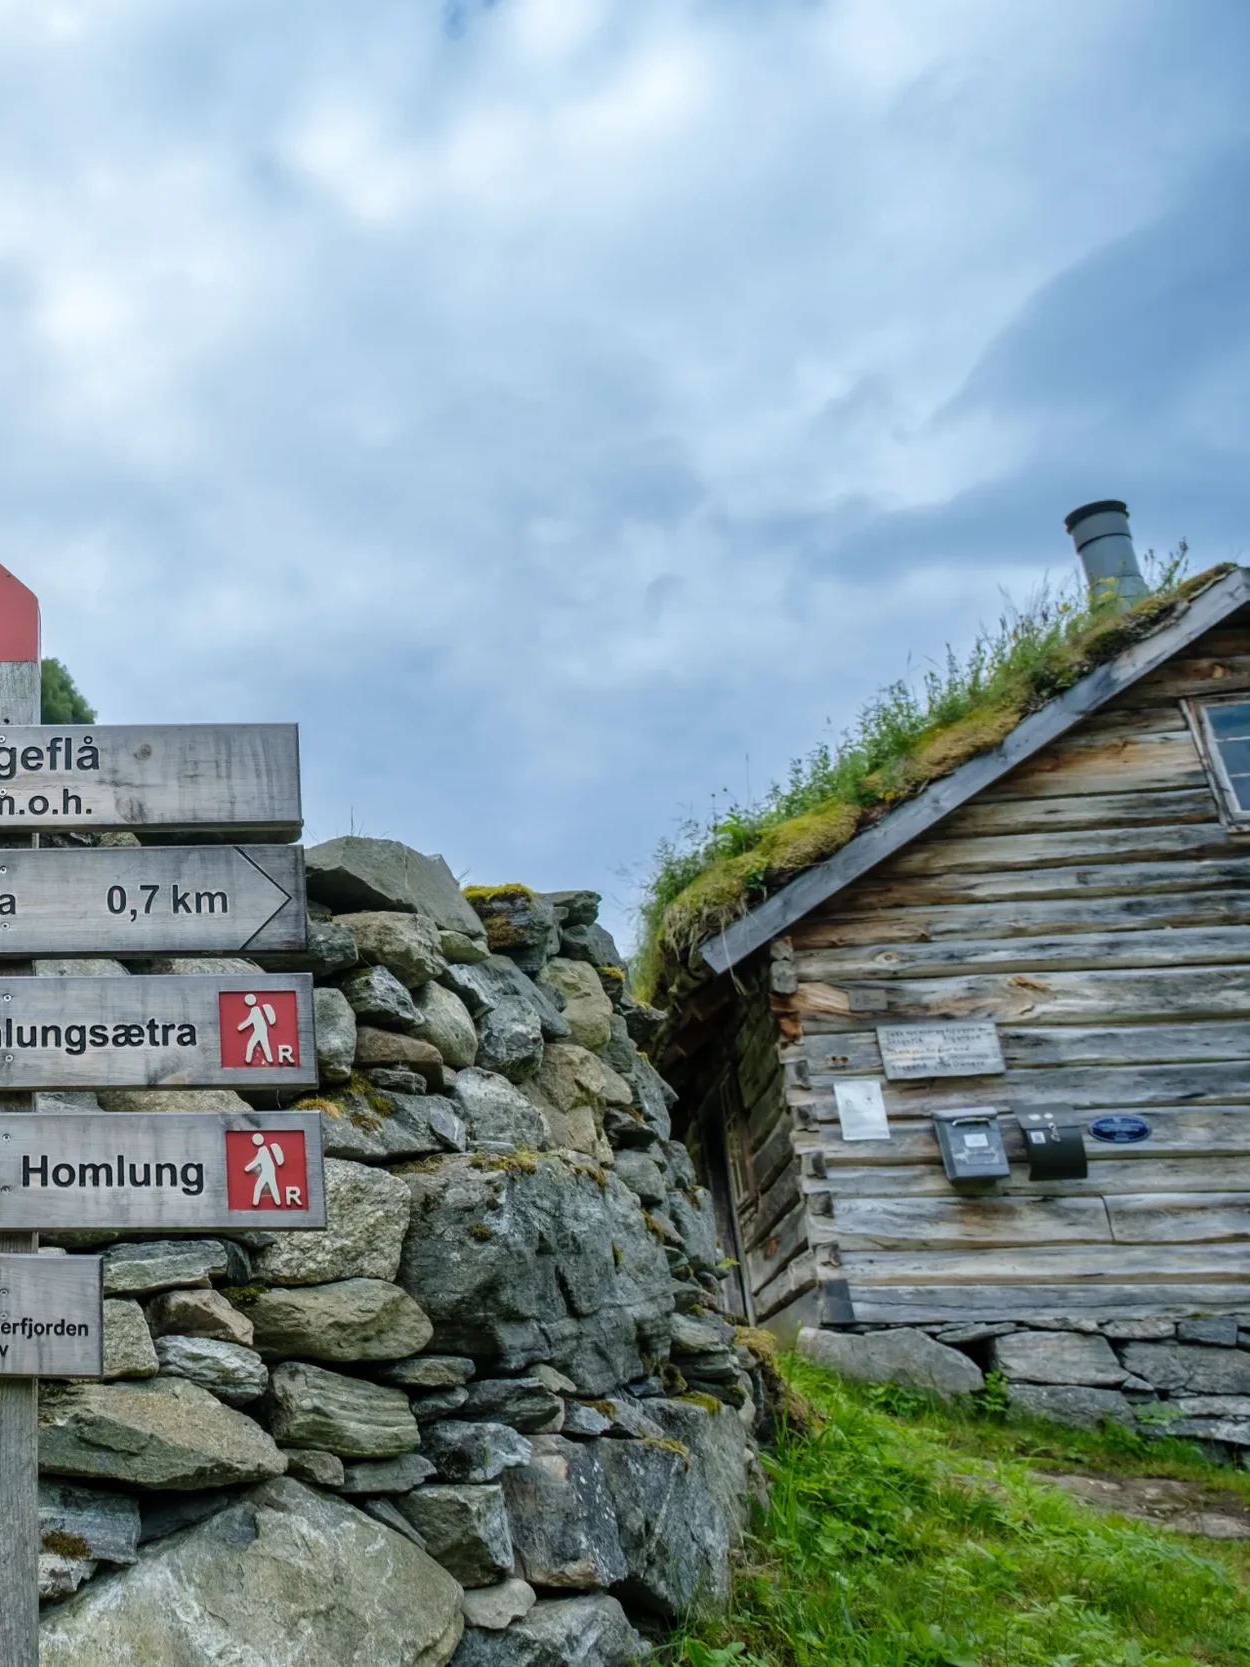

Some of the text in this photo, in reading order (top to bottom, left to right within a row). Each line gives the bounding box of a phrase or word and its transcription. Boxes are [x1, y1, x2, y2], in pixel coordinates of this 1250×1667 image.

[107, 884, 229, 923] 0,7 km
[278, 1045, 294, 1063] R
[21, 1154, 205, 1196] Homlung
[286, 1187, 302, 1205] R
